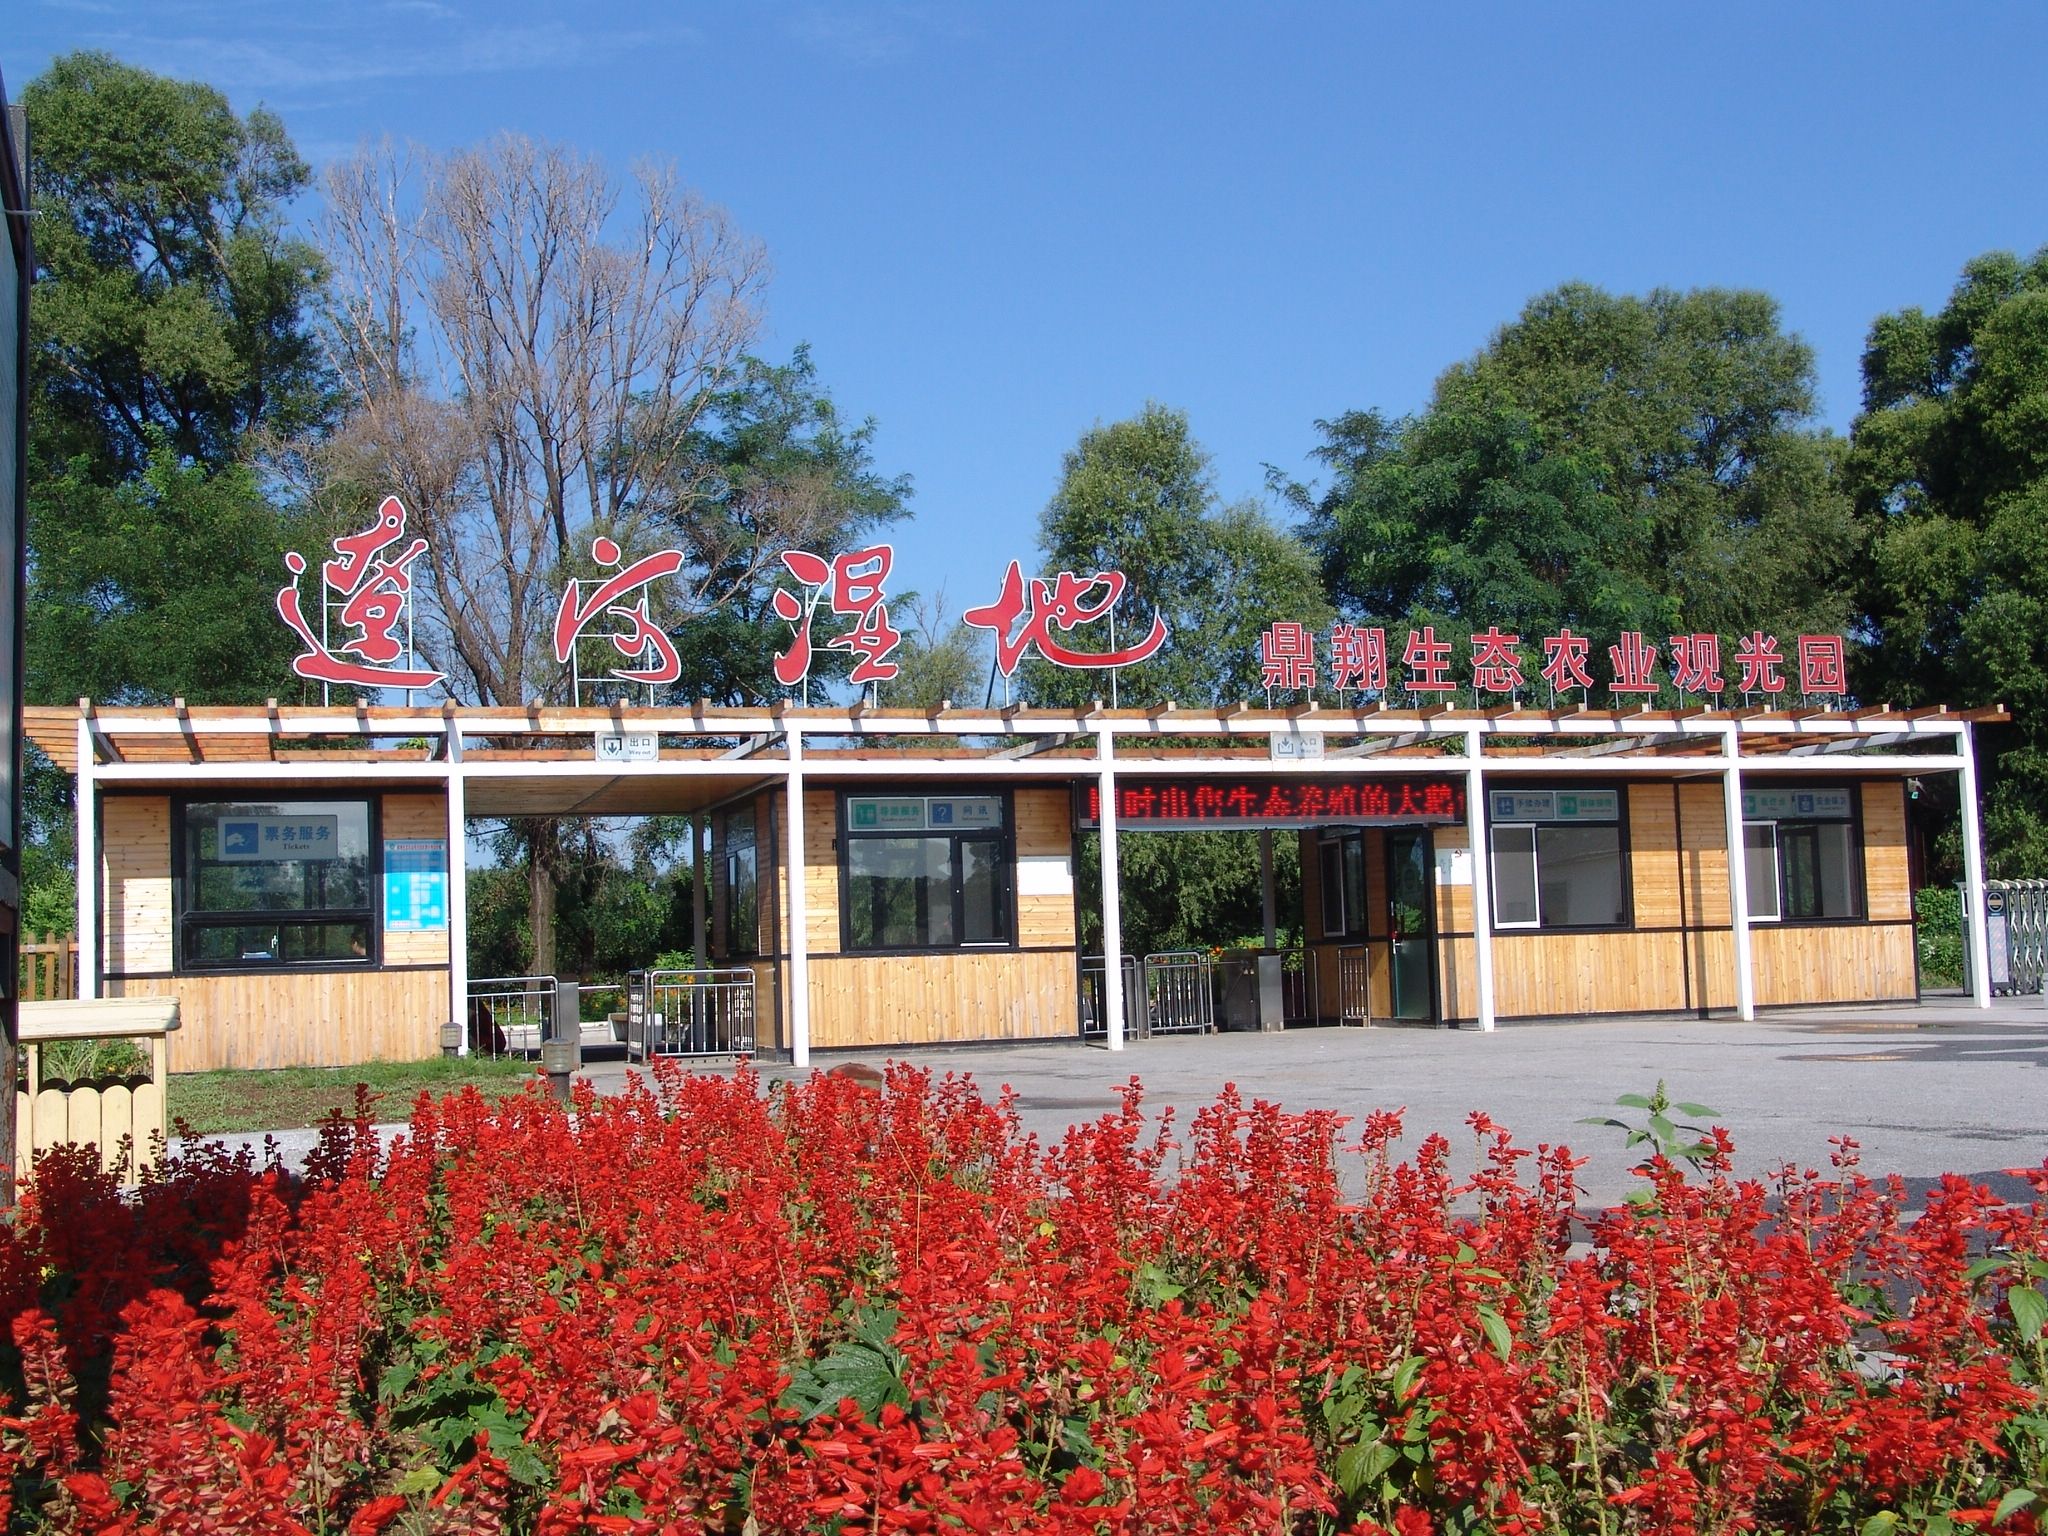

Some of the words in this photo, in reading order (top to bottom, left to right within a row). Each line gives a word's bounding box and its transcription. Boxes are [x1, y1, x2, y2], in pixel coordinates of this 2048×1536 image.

[1260, 620, 1848, 697] 鼎翔生态农业观光园
[629, 737, 651, 747] 出口
[1300, 737, 1317, 746] 入口
[264, 825, 331, 841] 票务服务
[283, 843, 310, 851] Tickets
